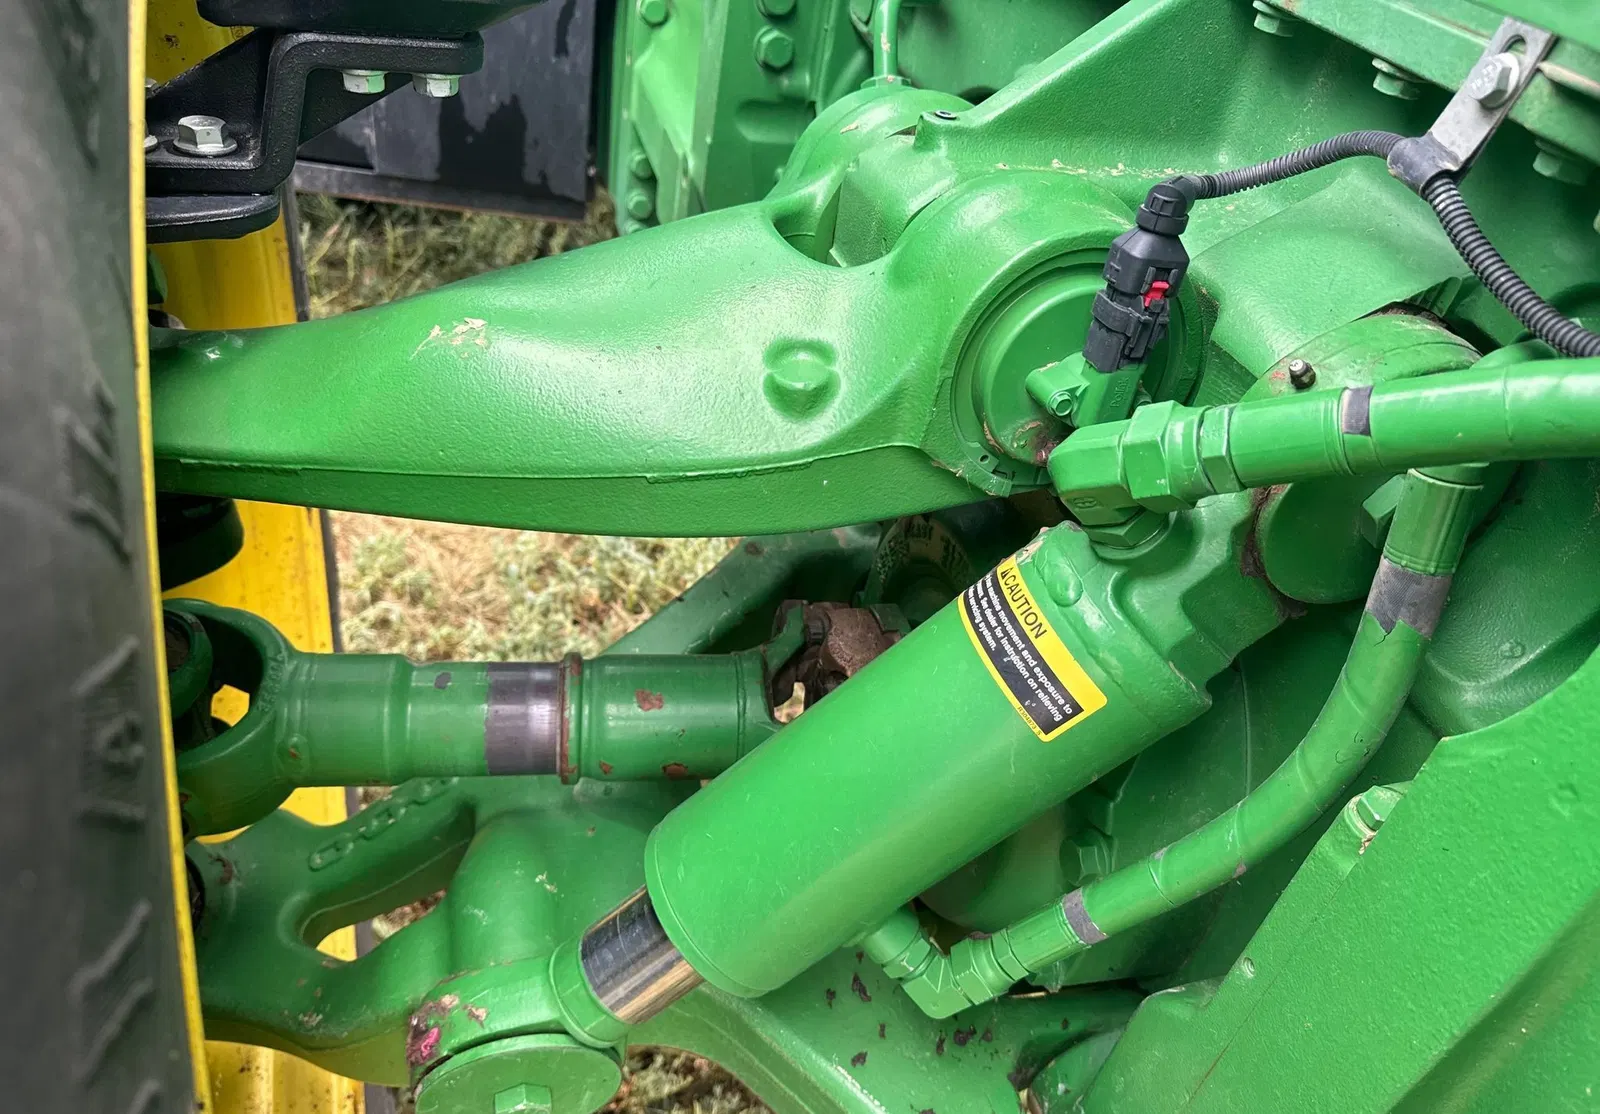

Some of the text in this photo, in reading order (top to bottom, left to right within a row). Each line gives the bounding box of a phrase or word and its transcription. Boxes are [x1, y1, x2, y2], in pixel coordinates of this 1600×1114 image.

[969, 597, 983, 624] servicing
[979, 622, 996, 652] system.
[988, 587, 1001, 611] machine
[998, 610, 1025, 650] movement
[1021, 649, 1037, 667] and
[1033, 666, 1065, 705] exposure
[1062, 703, 1073, 714] to
[1004, 574, 1047, 639] CAUTION
[984, 608, 998, 628] dealer
[994, 626, 1004, 639] for
[1000, 636, 1030, 679] instruction
[1027, 678, 1038, 690] on
[1034, 689, 1063, 722] relieving
